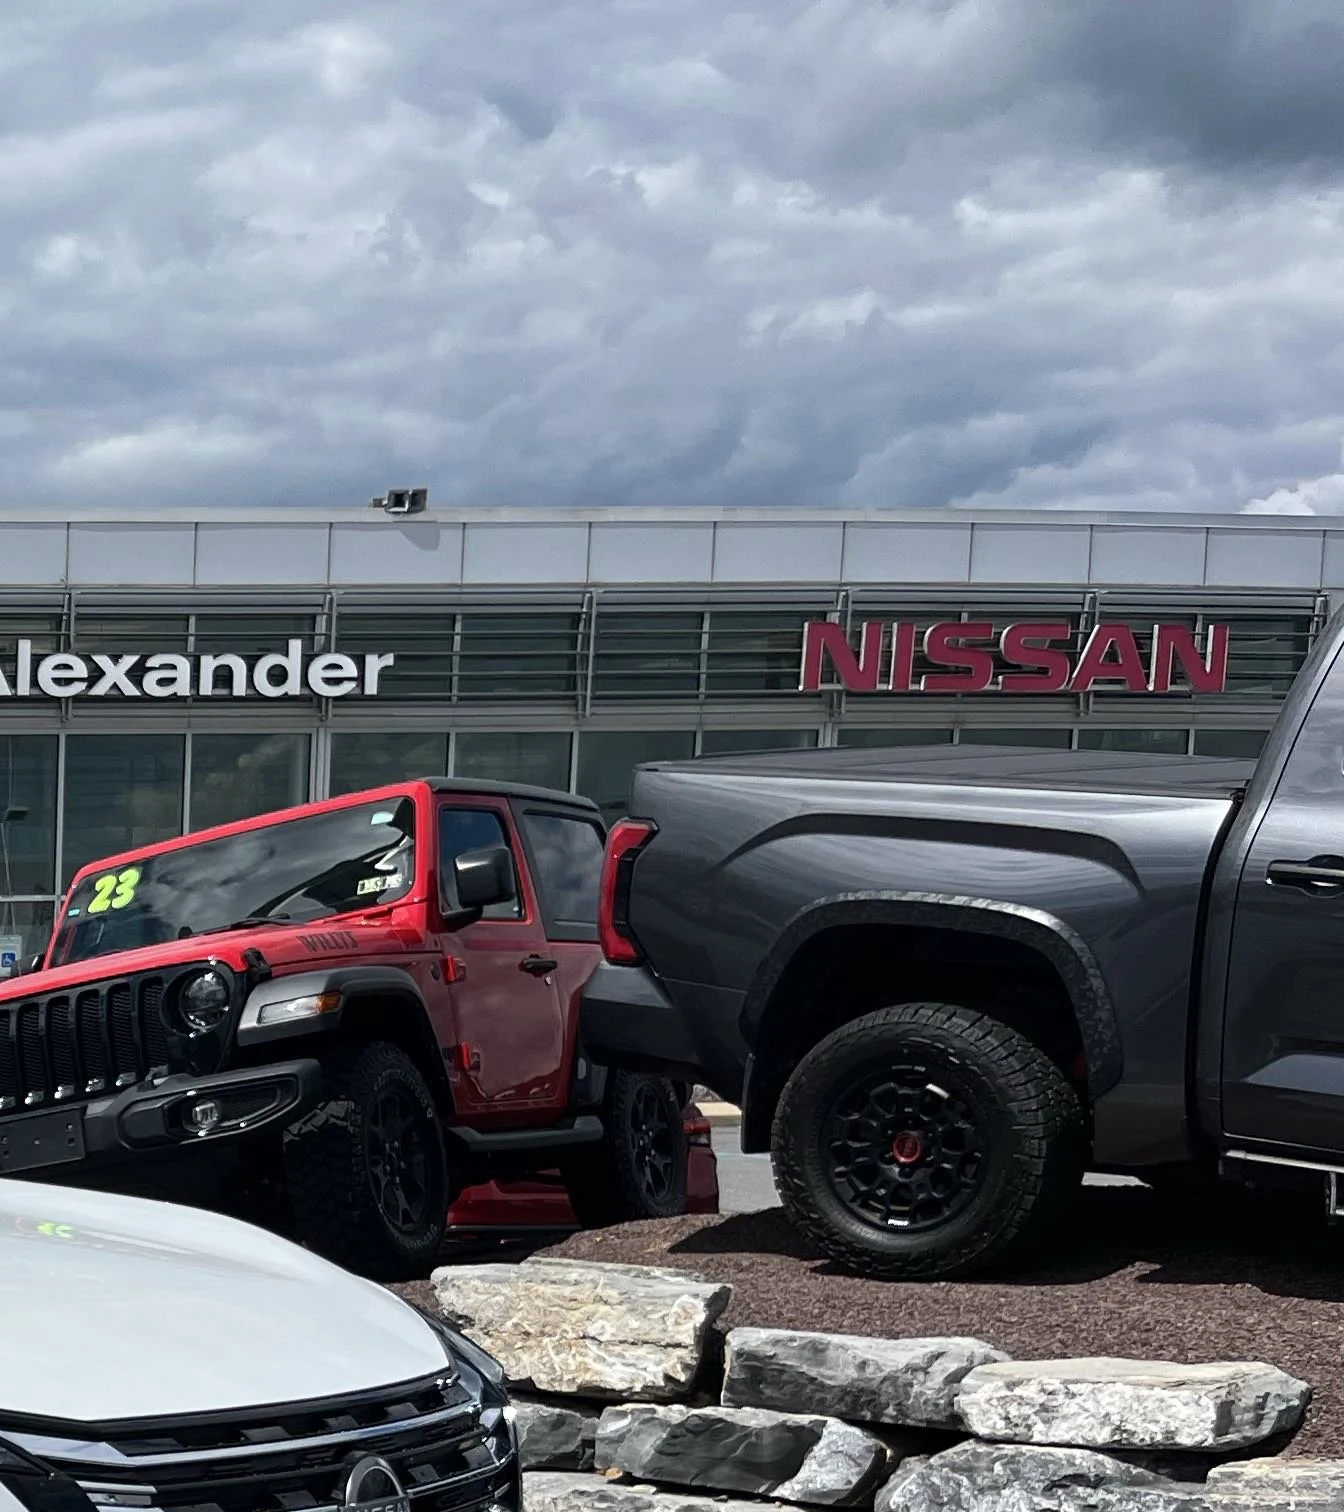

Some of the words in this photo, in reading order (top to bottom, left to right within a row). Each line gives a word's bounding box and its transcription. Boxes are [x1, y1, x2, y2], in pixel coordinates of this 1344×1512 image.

[798, 622, 1230, 692] NISSAN
[88, 868, 140, 913] 23
[295, 930, 359, 953] WILLYS
